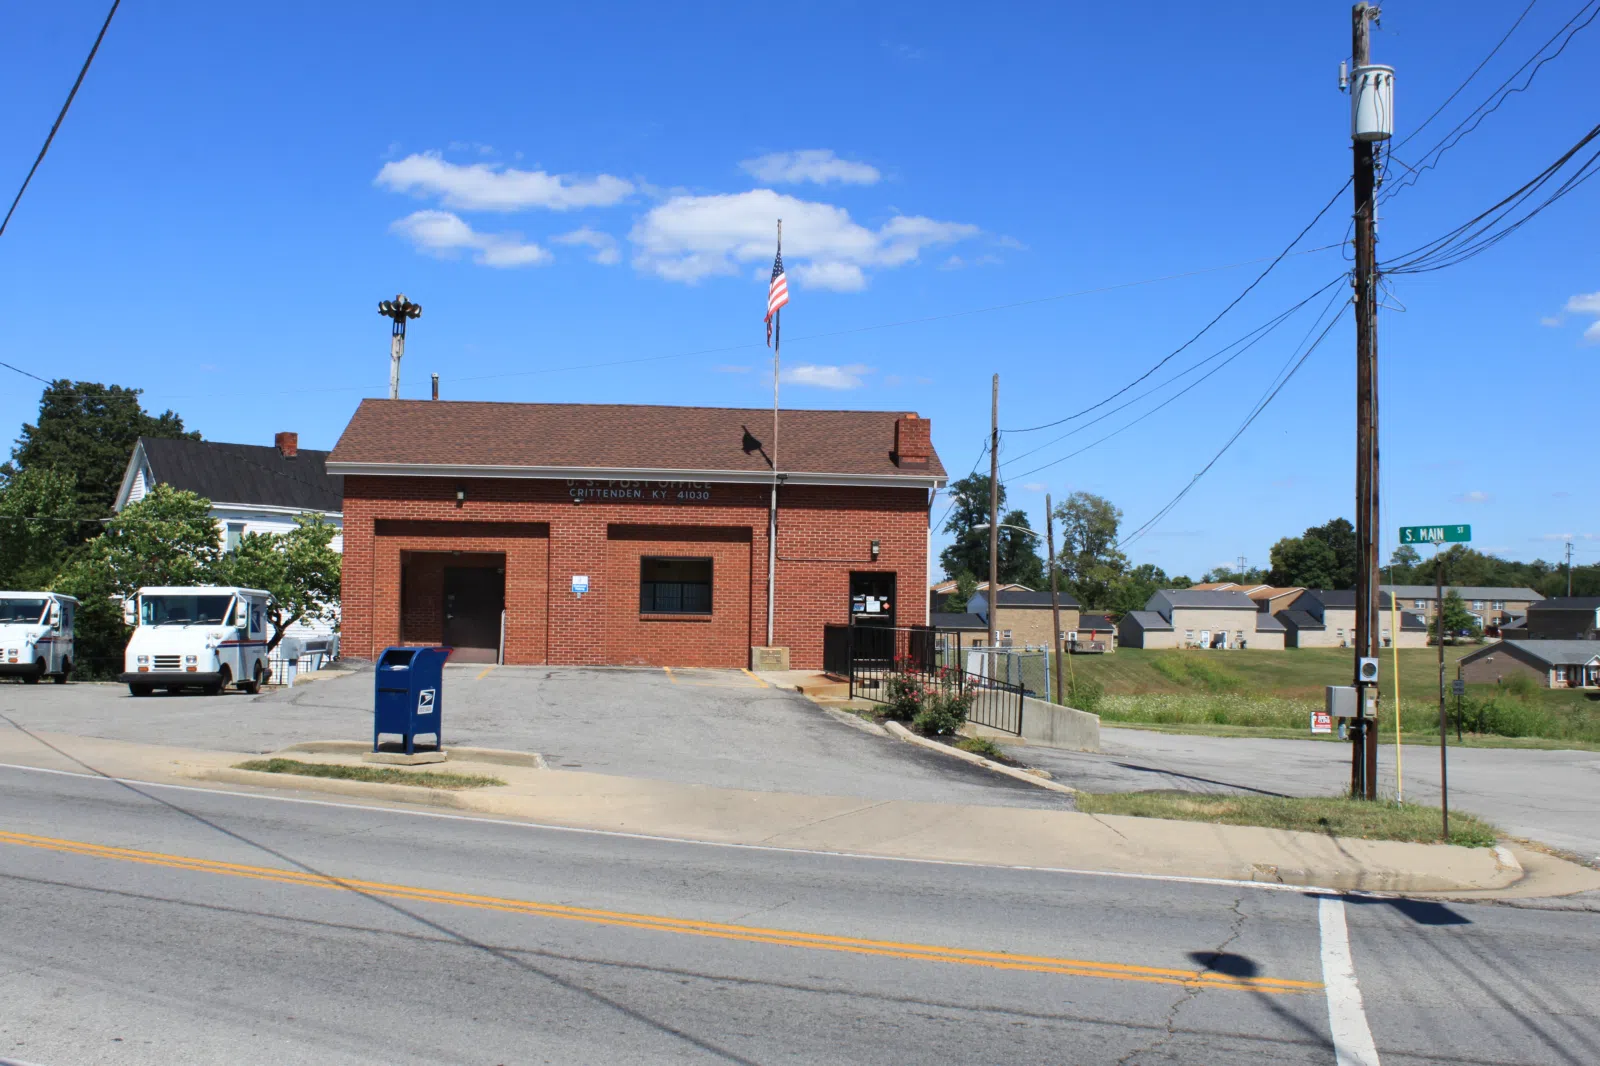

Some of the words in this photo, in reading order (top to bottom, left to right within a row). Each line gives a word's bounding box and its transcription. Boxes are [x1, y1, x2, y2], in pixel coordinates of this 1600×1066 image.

[652, 489, 668, 499] KY
[677, 490, 710, 500] 41030
[1405, 529, 1415, 541] S.
[1420, 528, 1444, 540] MAIN
